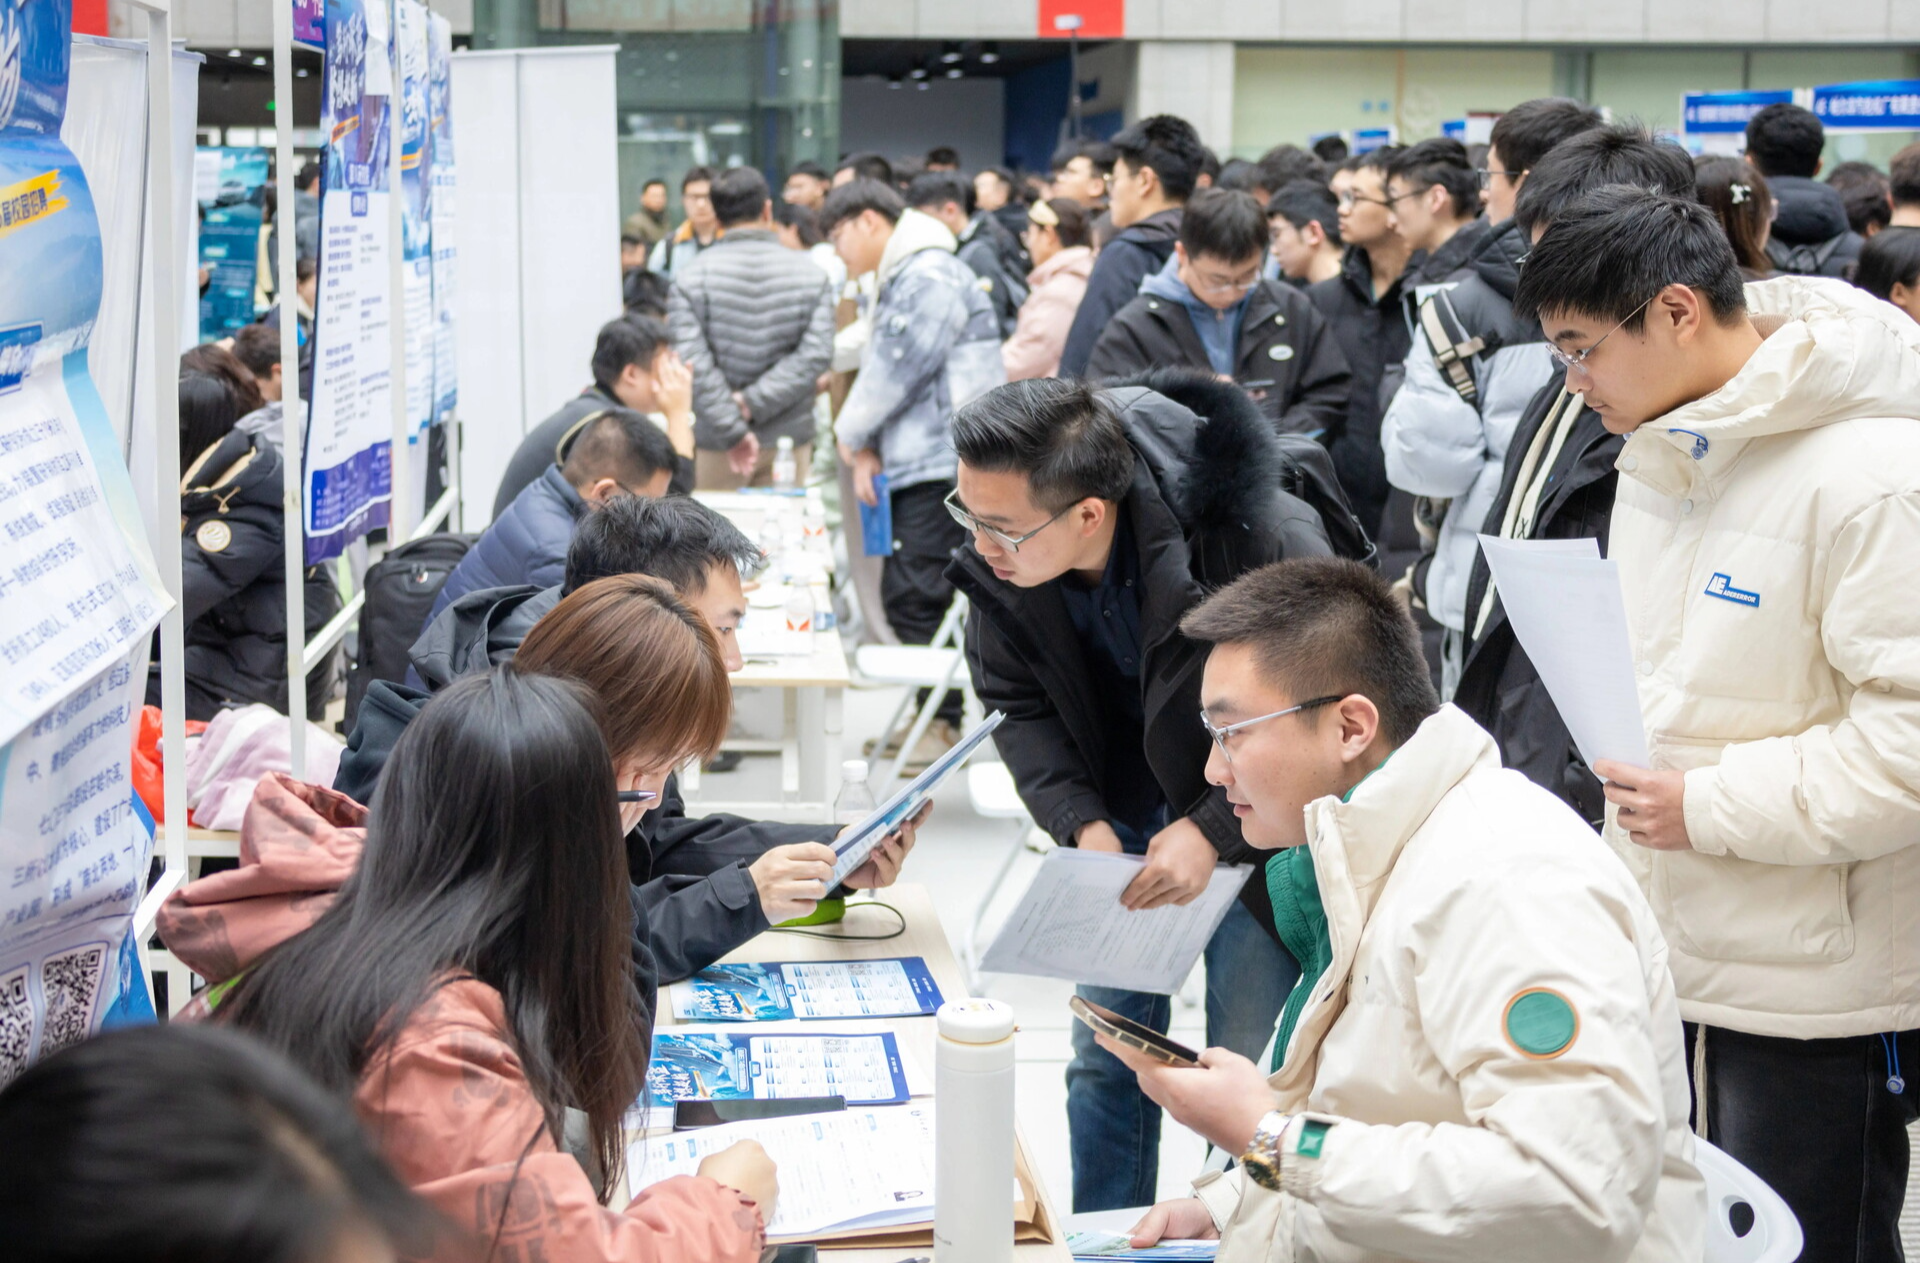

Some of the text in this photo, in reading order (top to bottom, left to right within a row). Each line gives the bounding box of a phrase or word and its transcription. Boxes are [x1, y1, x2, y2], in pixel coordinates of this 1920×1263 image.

[0, 187, 49, 228] 届校园招聘
